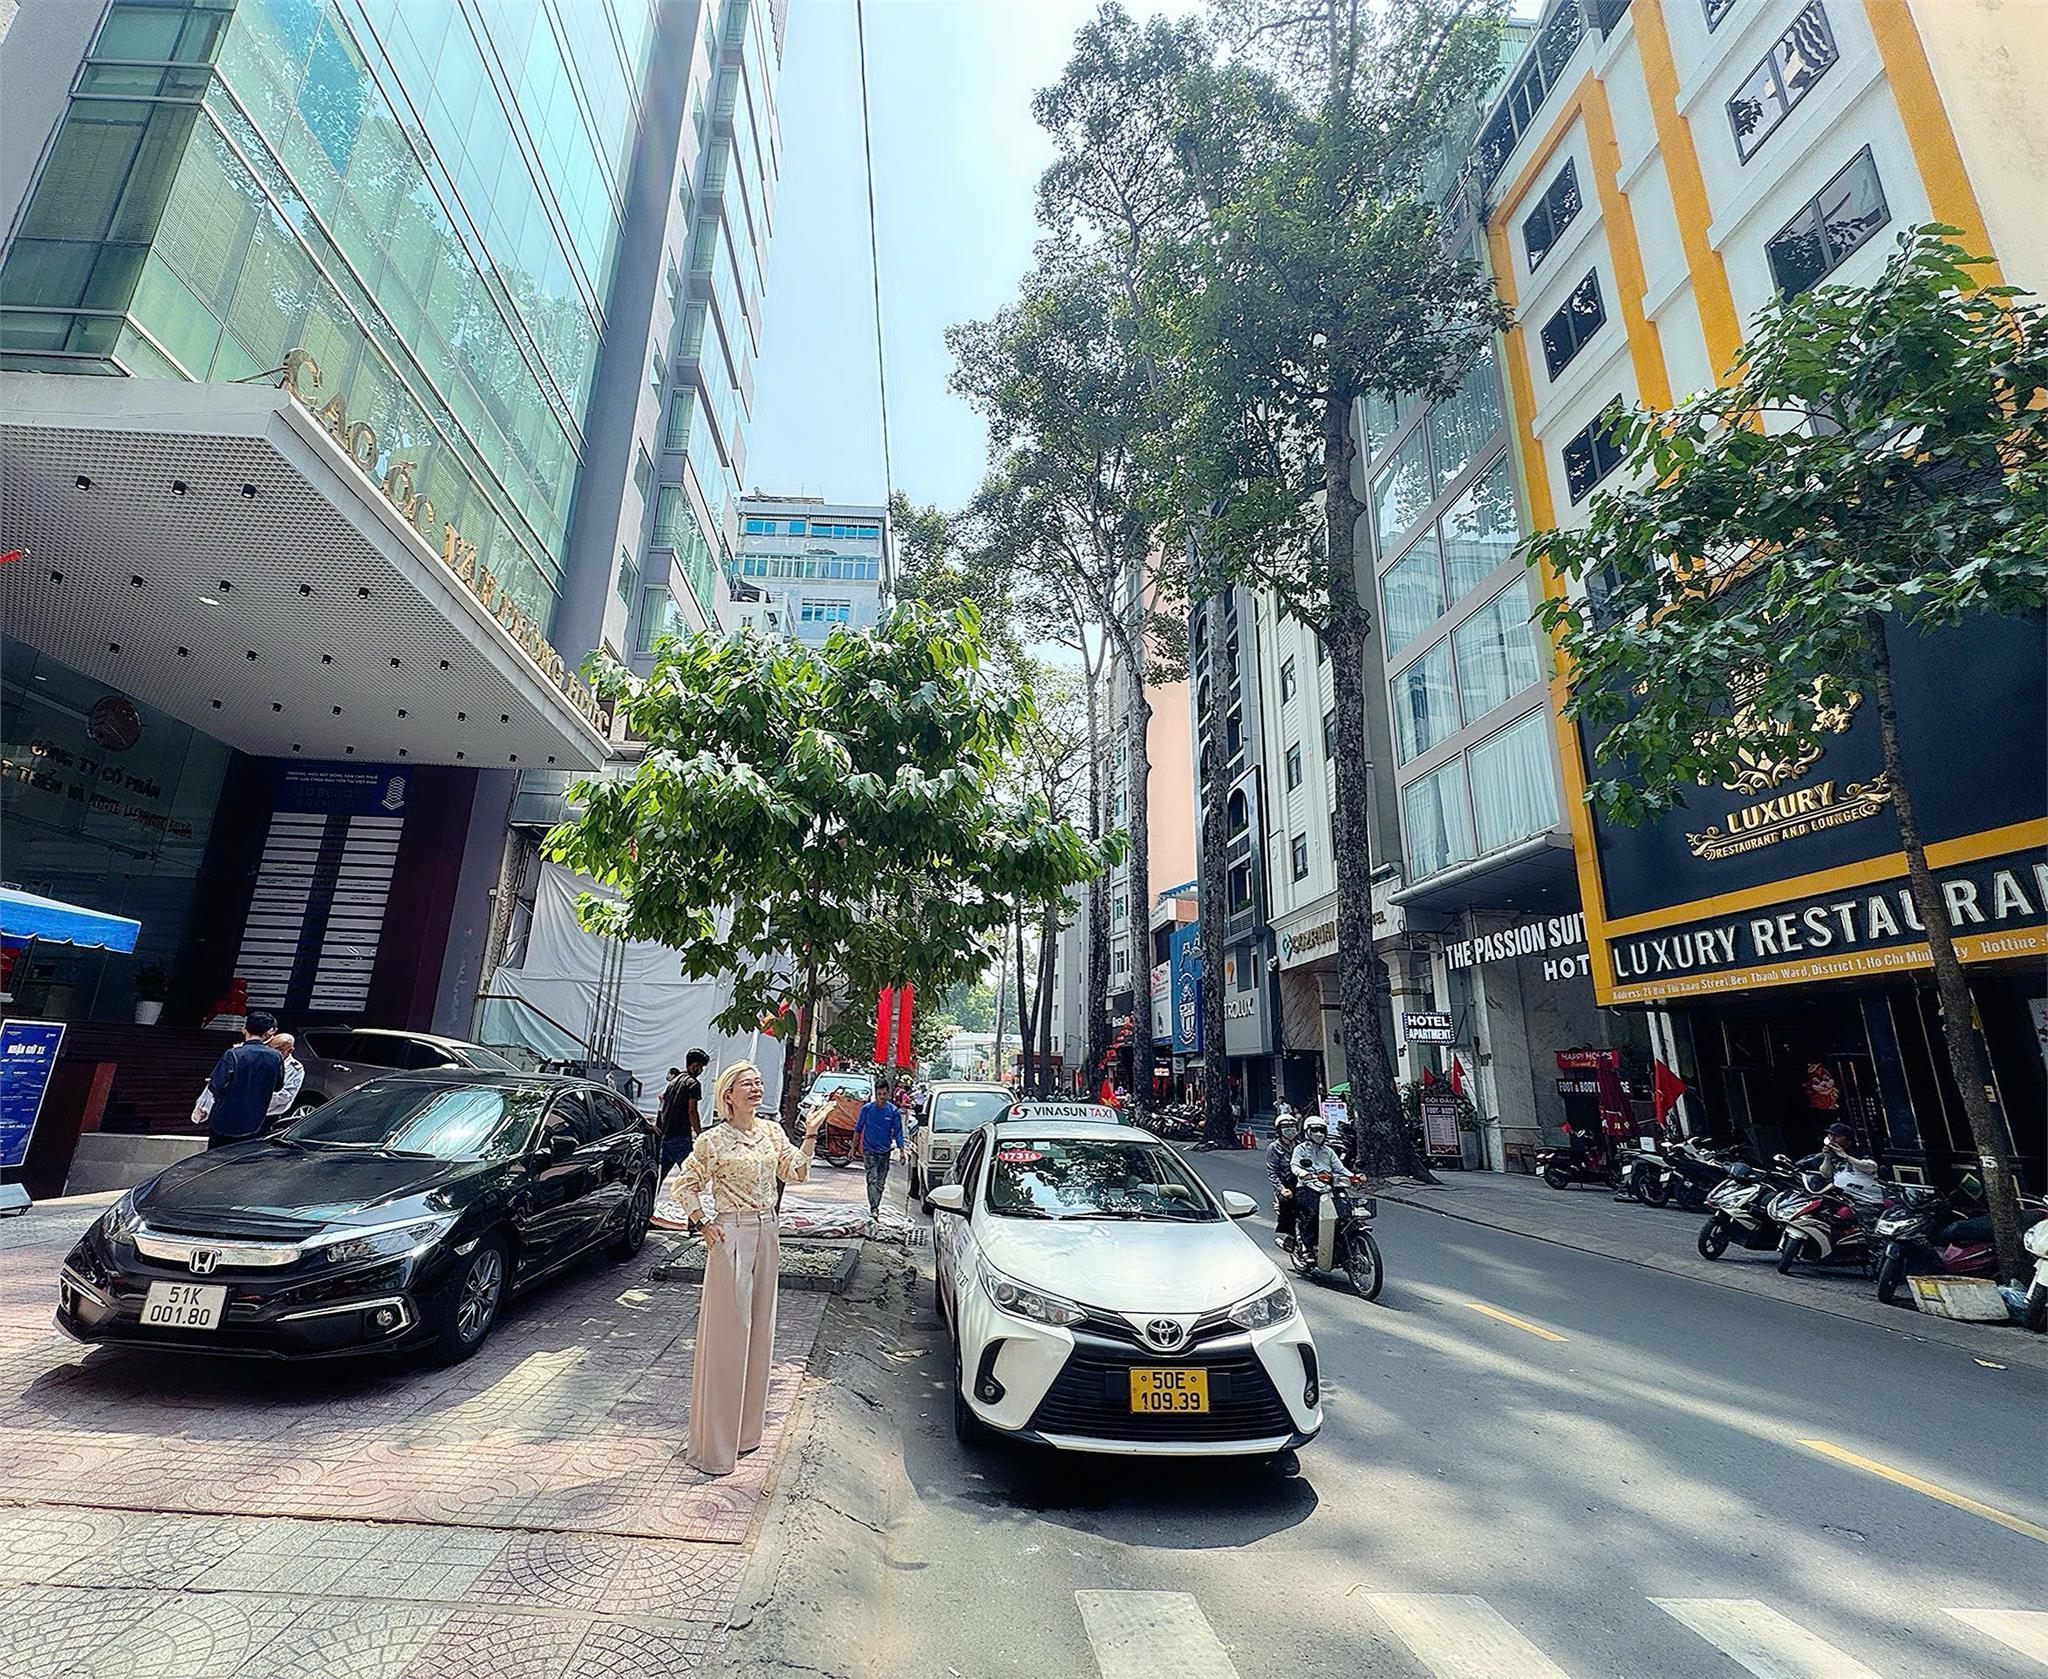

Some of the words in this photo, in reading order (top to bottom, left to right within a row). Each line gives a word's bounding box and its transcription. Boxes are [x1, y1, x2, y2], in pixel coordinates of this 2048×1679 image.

[283, 347, 379, 472] CAO
[1726, 780, 1836, 835] LUXURY
[1715, 831, 1779, 860] RESTAURANT
[1781, 822, 1806, 841] AND
[1810, 810, 1860, 832] LOUNGE
[1613, 925, 1736, 978] LUXURY
[1751, 862, 2048, 957] RESTAURA
[1446, 941, 1472, 970] THE
[1474, 922, 1546, 965] PASSION
[1548, 911, 1589, 948] SUIT
[1543, 953, 1590, 981] HOT
[1750, 970, 1779, 983] Thanh
[1884, 952, 1904, 966] Chi
[1981, 937, 2037, 954] Hotline
[1407, 1015, 1450, 1027] HOTEL
[1409, 1028, 1451, 1040] APARTMENT
[1561, 1051, 1584, 1061] HAPPY
[1559, 1081, 1574, 1093] FOOT
[1580, 1081, 1597, 1093] BODY
[1033, 1106, 1087, 1117] VINASUN
[1089, 1107, 1112, 1119] TAXI
[168, 1286, 202, 1305] 51K
[150, 1305, 211, 1326] 001.80
[1152, 1371, 1186, 1390] 50E
[1141, 1392, 1201, 1411] 109.39
